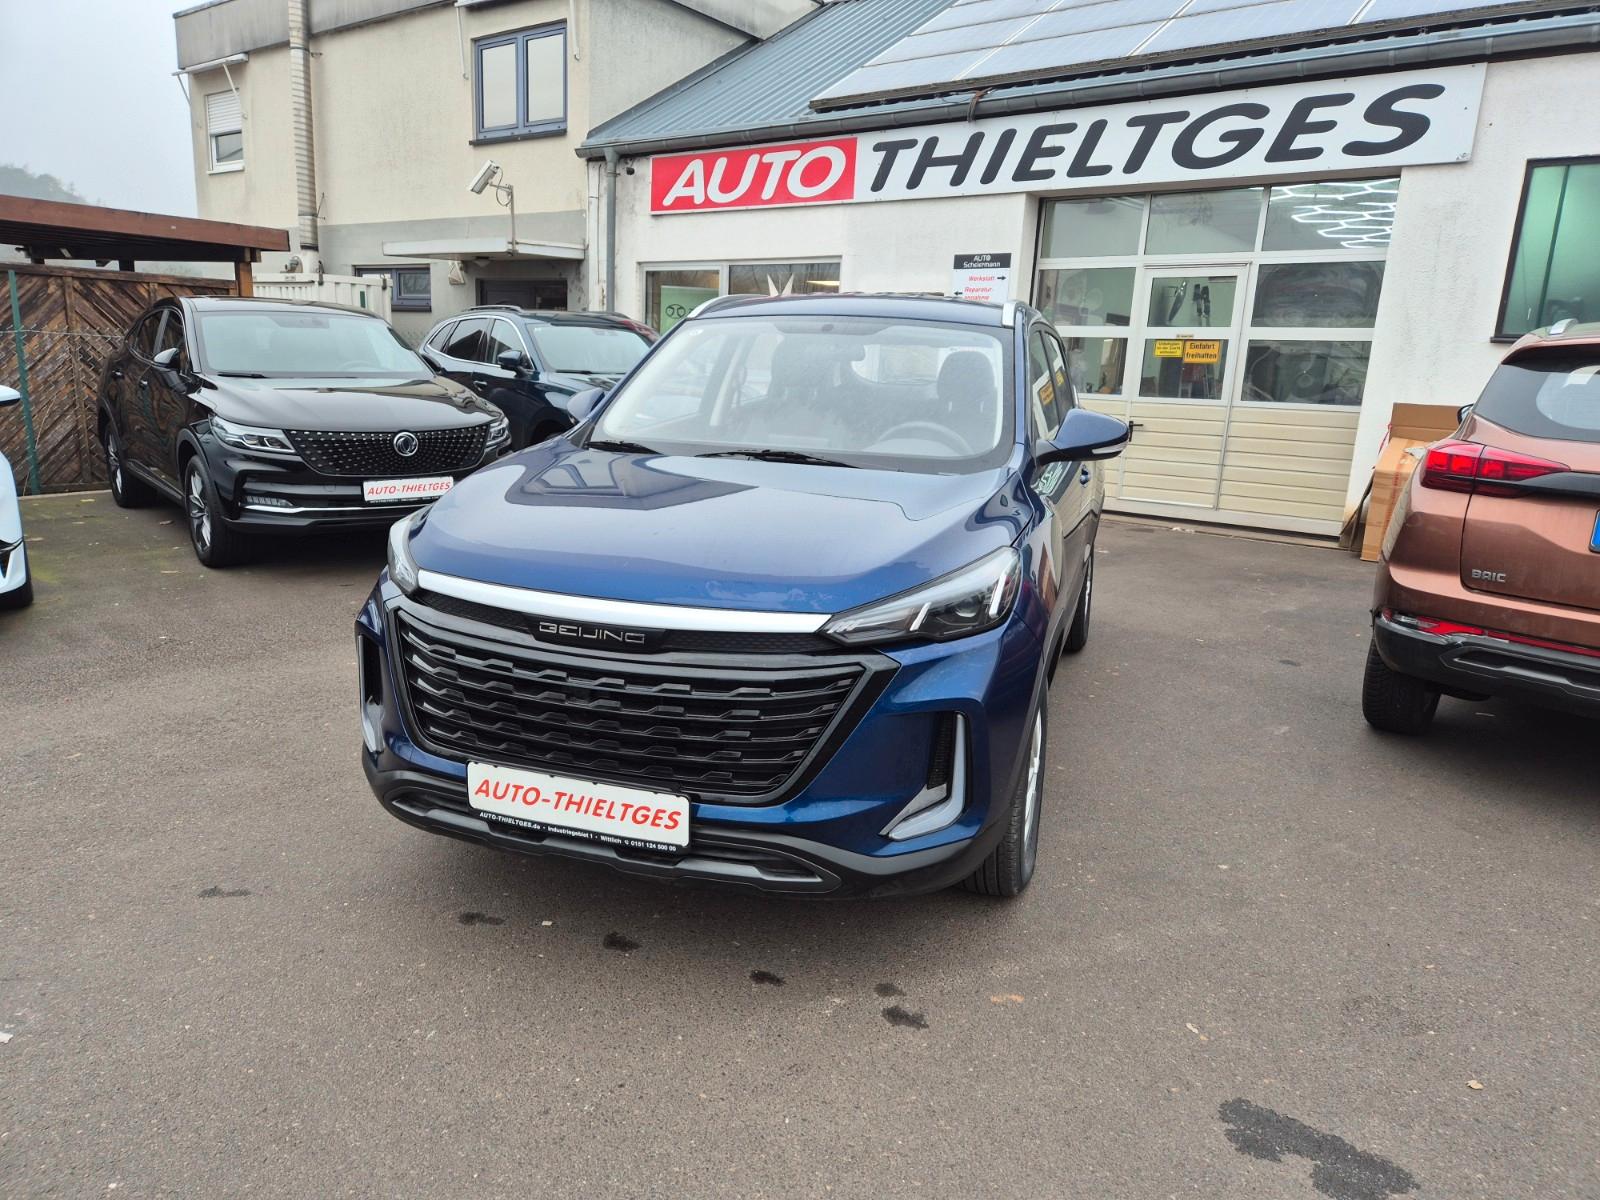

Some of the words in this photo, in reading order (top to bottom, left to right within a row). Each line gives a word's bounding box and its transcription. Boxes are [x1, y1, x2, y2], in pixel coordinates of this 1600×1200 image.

[662, 145, 847, 207] AUTO
[871, 83, 1446, 192] THIELTGES
[973, 254, 992, 262] AUTO
[1189, 342, 1216, 350] Einfahrt
[367, 481, 451, 496] AUTO-THIELTGES
[1471, 568, 1506, 583] BAIC
[539, 621, 645, 644] BEIJING
[474, 778, 682, 830] AUTO-THIELTGES
[479, 811, 541, 830] AUTO-THIELTGES.de
[600, 835, 622, 844] Wittlich
